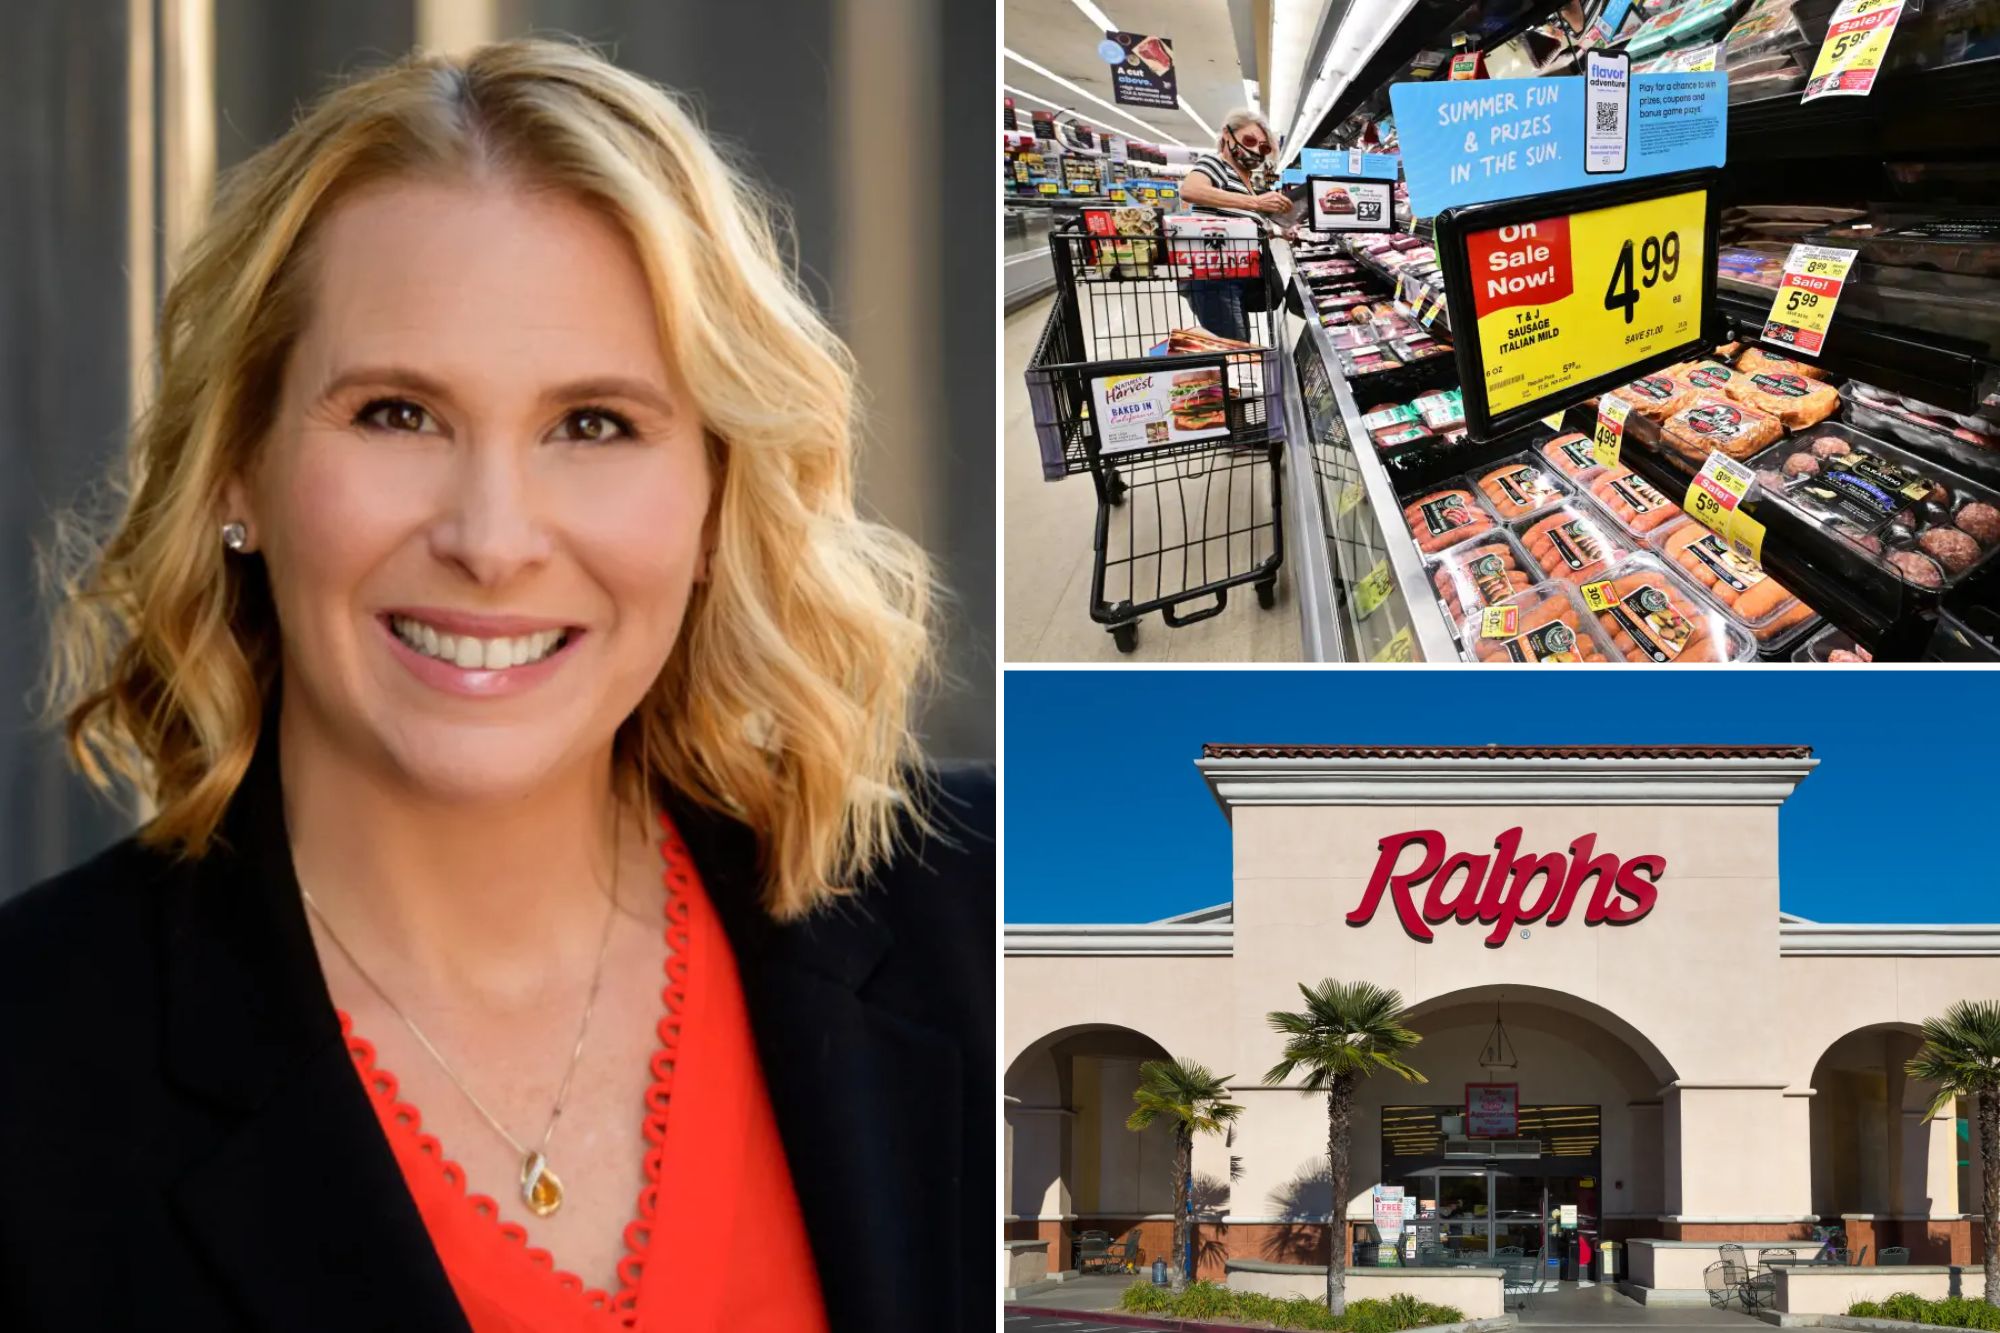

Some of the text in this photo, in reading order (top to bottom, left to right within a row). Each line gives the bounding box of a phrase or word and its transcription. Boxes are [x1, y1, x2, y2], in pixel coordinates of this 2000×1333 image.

[1838, 13, 1885, 32] Sale!
[1591, 63, 1625, 80] flavor
[1590, 79, 1626, 89] adventure
[1639, 83, 1655, 94] Play
[1655, 82, 1665, 91] for
[1672, 80, 1697, 90] chance
[1698, 81, 1705, 89] to
[1705, 80, 1717, 89] win
[1437, 84, 1559, 126] SUMMER FUN
[1663, 94, 1691, 105] coupons
[1692, 93, 1705, 101] and
[1639, 109, 1662, 119] bonus
[1662, 107, 1683, 118] game
[1464, 114, 1552, 153] & PRIZES
[1450, 141, 1562, 186] IN THE SUN.
[1499, 223, 1537, 243] On
[1488, 245, 1550, 271] Sale
[1807, 261, 1828, 273] 899
[1487, 265, 1555, 299] Now!
[1791, 275, 1829, 291] Sale!
[1672, 295, 1682, 304] ea
[1786, 291, 1819, 312] 599
[1516, 308, 1540, 324] T & J
[1507, 318, 1550, 340] SAUSAGE
[1624, 331, 1645, 345] SAVE
[1644, 324, 1664, 339] $1.00
[1499, 327, 1560, 355] ITALIAN MILD
[1492, 366, 1503, 374] OZ
[1105, 375, 1154, 405] Harvest
[1111, 402, 1153, 417] BAKED IN
[1596, 425, 1617, 448] 499
[1859, 464, 1900, 487] CARANDO
[1700, 479, 1729, 502] Sale!
[1695, 492, 1720, 514] 599
[1345, 826, 1667, 949] Ralphs
